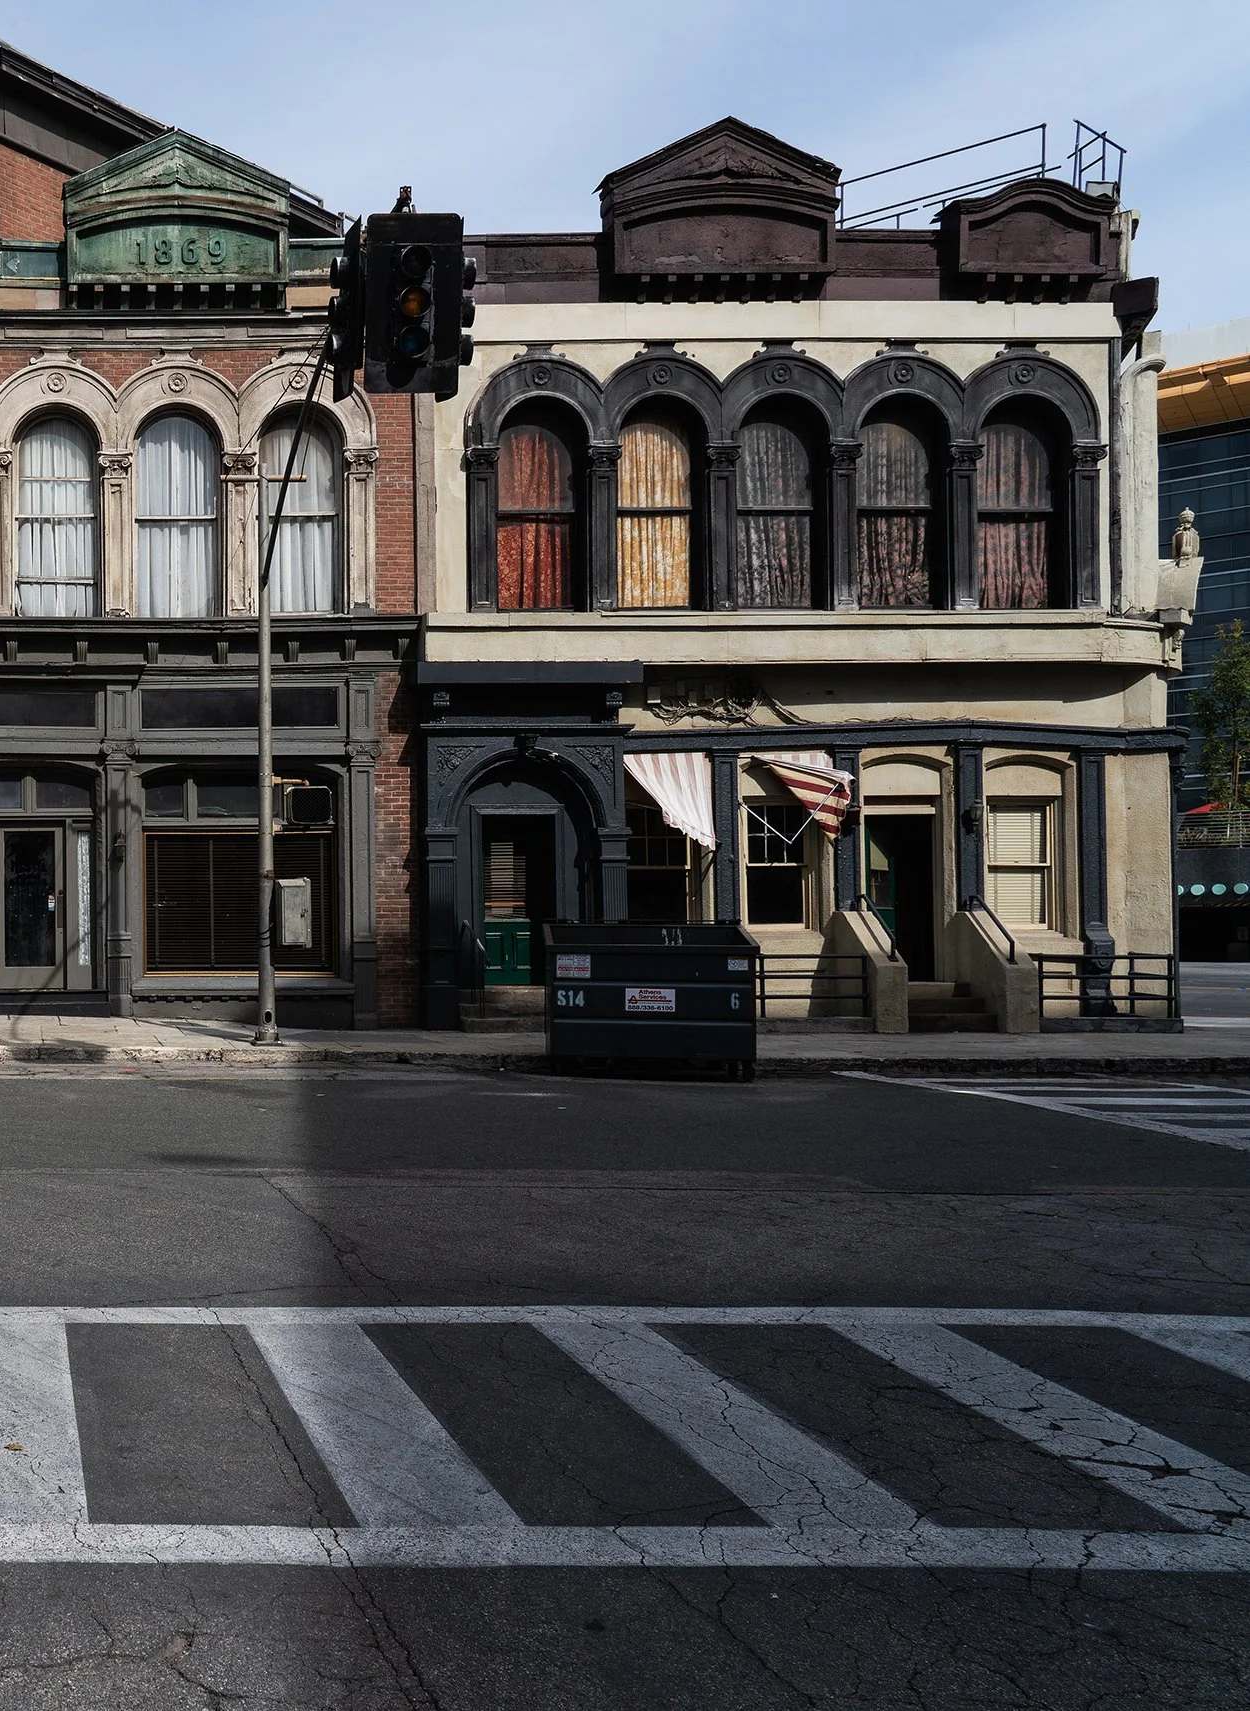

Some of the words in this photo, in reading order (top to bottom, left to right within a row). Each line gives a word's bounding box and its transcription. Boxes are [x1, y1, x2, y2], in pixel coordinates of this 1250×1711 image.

[135, 236, 227, 265] 1869
[557, 989, 585, 1007] S14
[730, 992, 740, 1010] 6
